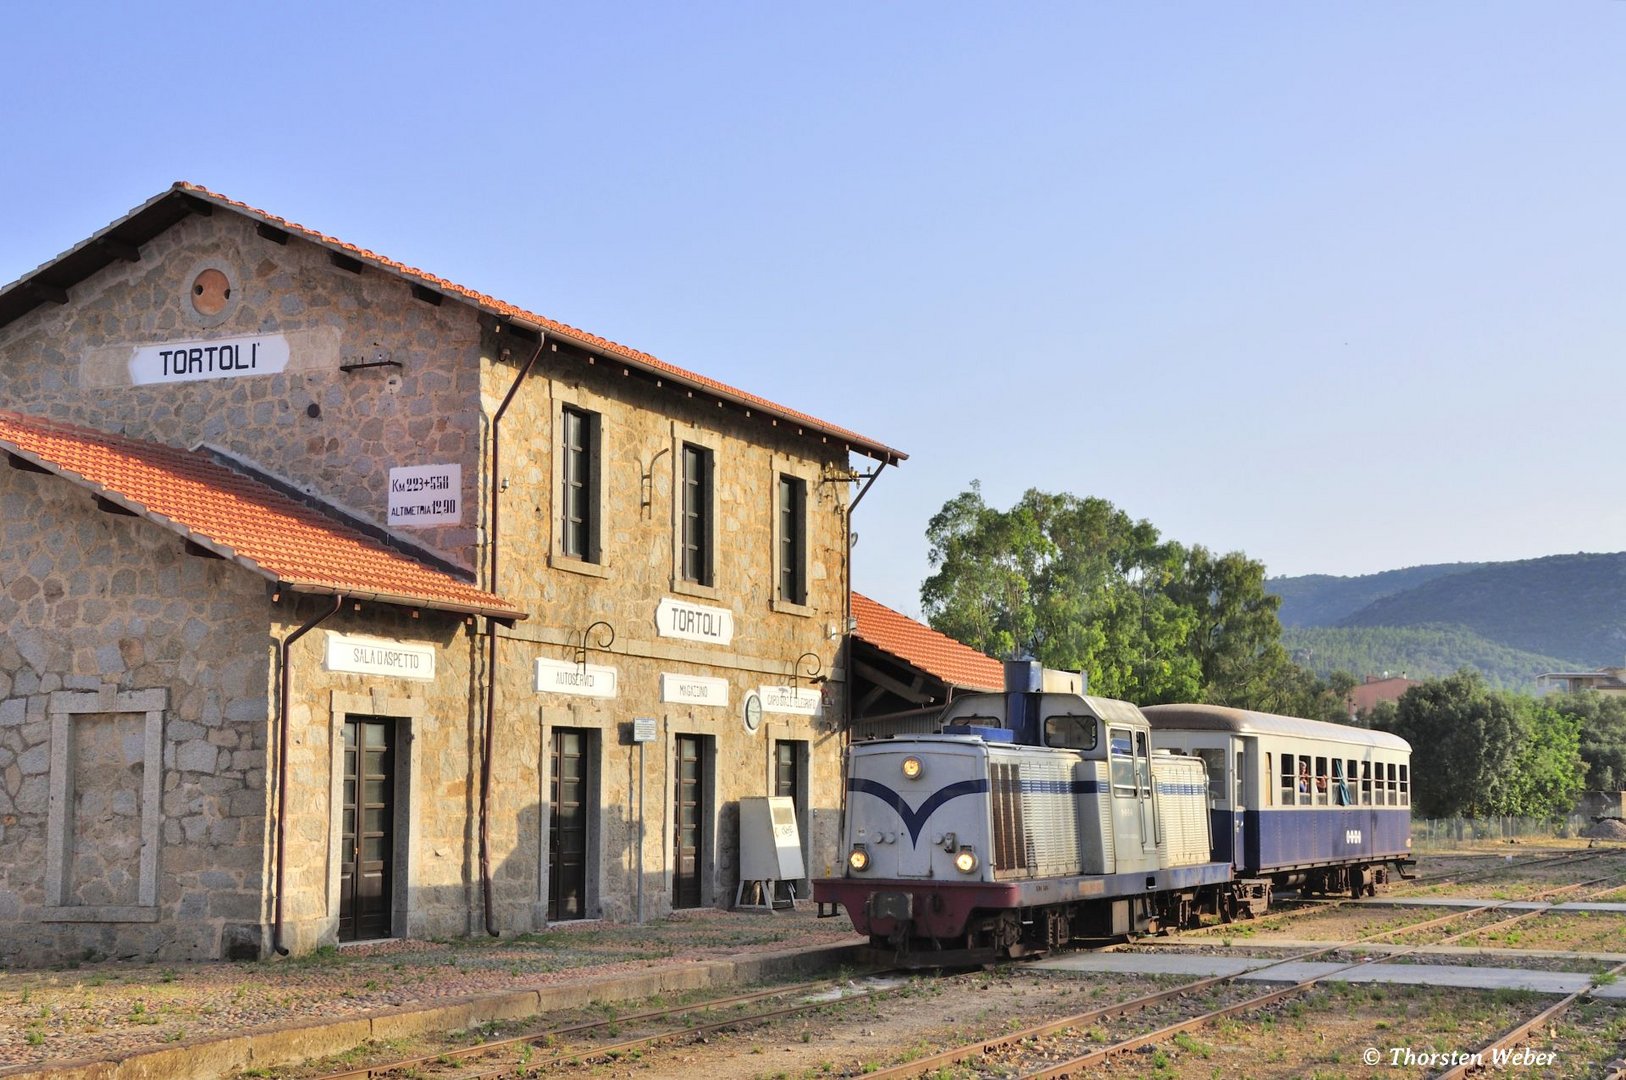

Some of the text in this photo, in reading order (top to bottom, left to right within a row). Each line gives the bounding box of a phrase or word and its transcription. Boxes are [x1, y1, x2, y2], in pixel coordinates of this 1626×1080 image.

[159, 342, 260, 376] TORTOLI'
[391, 505, 431, 517] ALTIMETRIA
[671, 607, 722, 637] TORTOLI
[353, 647, 376, 665] SALA
